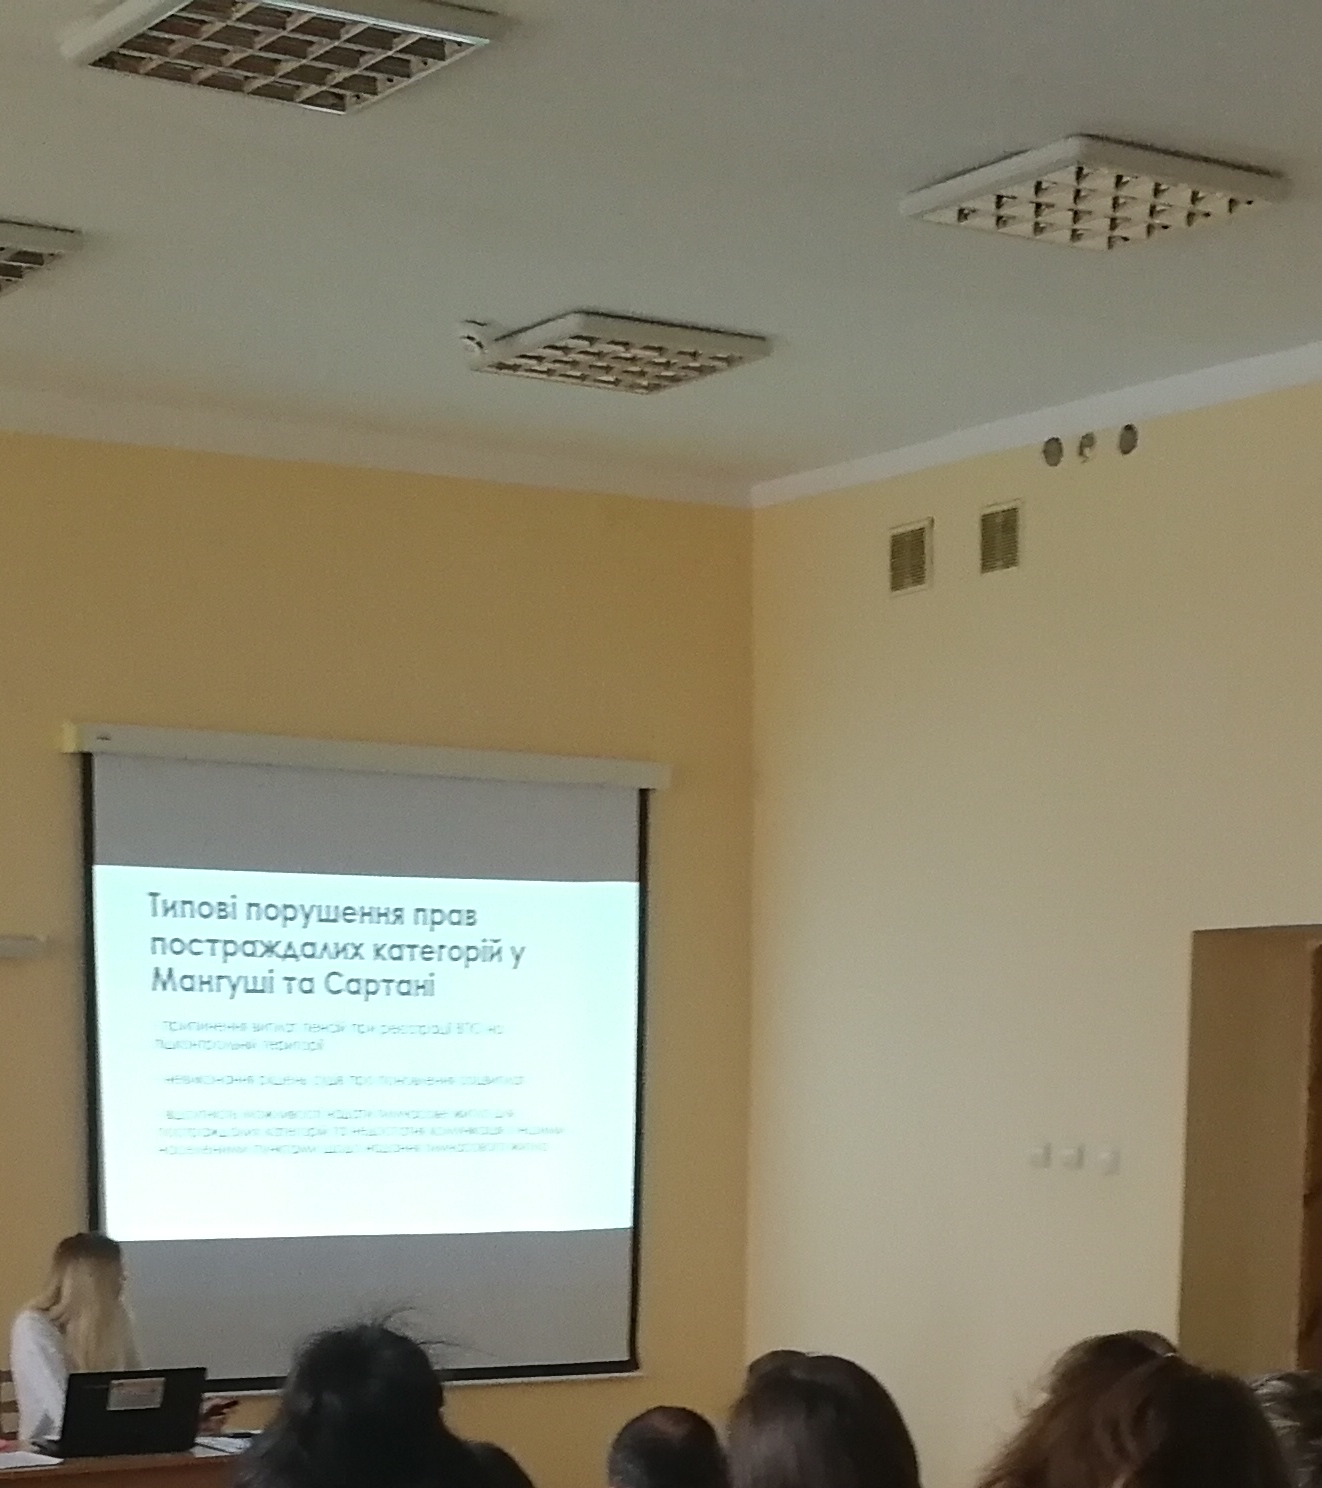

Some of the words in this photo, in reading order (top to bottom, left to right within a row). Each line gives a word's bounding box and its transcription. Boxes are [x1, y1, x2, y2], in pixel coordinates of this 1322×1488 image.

[146, 891, 238, 921] Типові
[246, 899, 405, 928] порушення
[413, 906, 478, 931] прав
[150, 936, 365, 963] постраждалих
[373, 938, 504, 967] категорій
[510, 946, 526, 968] у
[151, 967, 275, 1000] Мангуші
[283, 976, 316, 997] та
[324, 972, 436, 1002] Сартані
